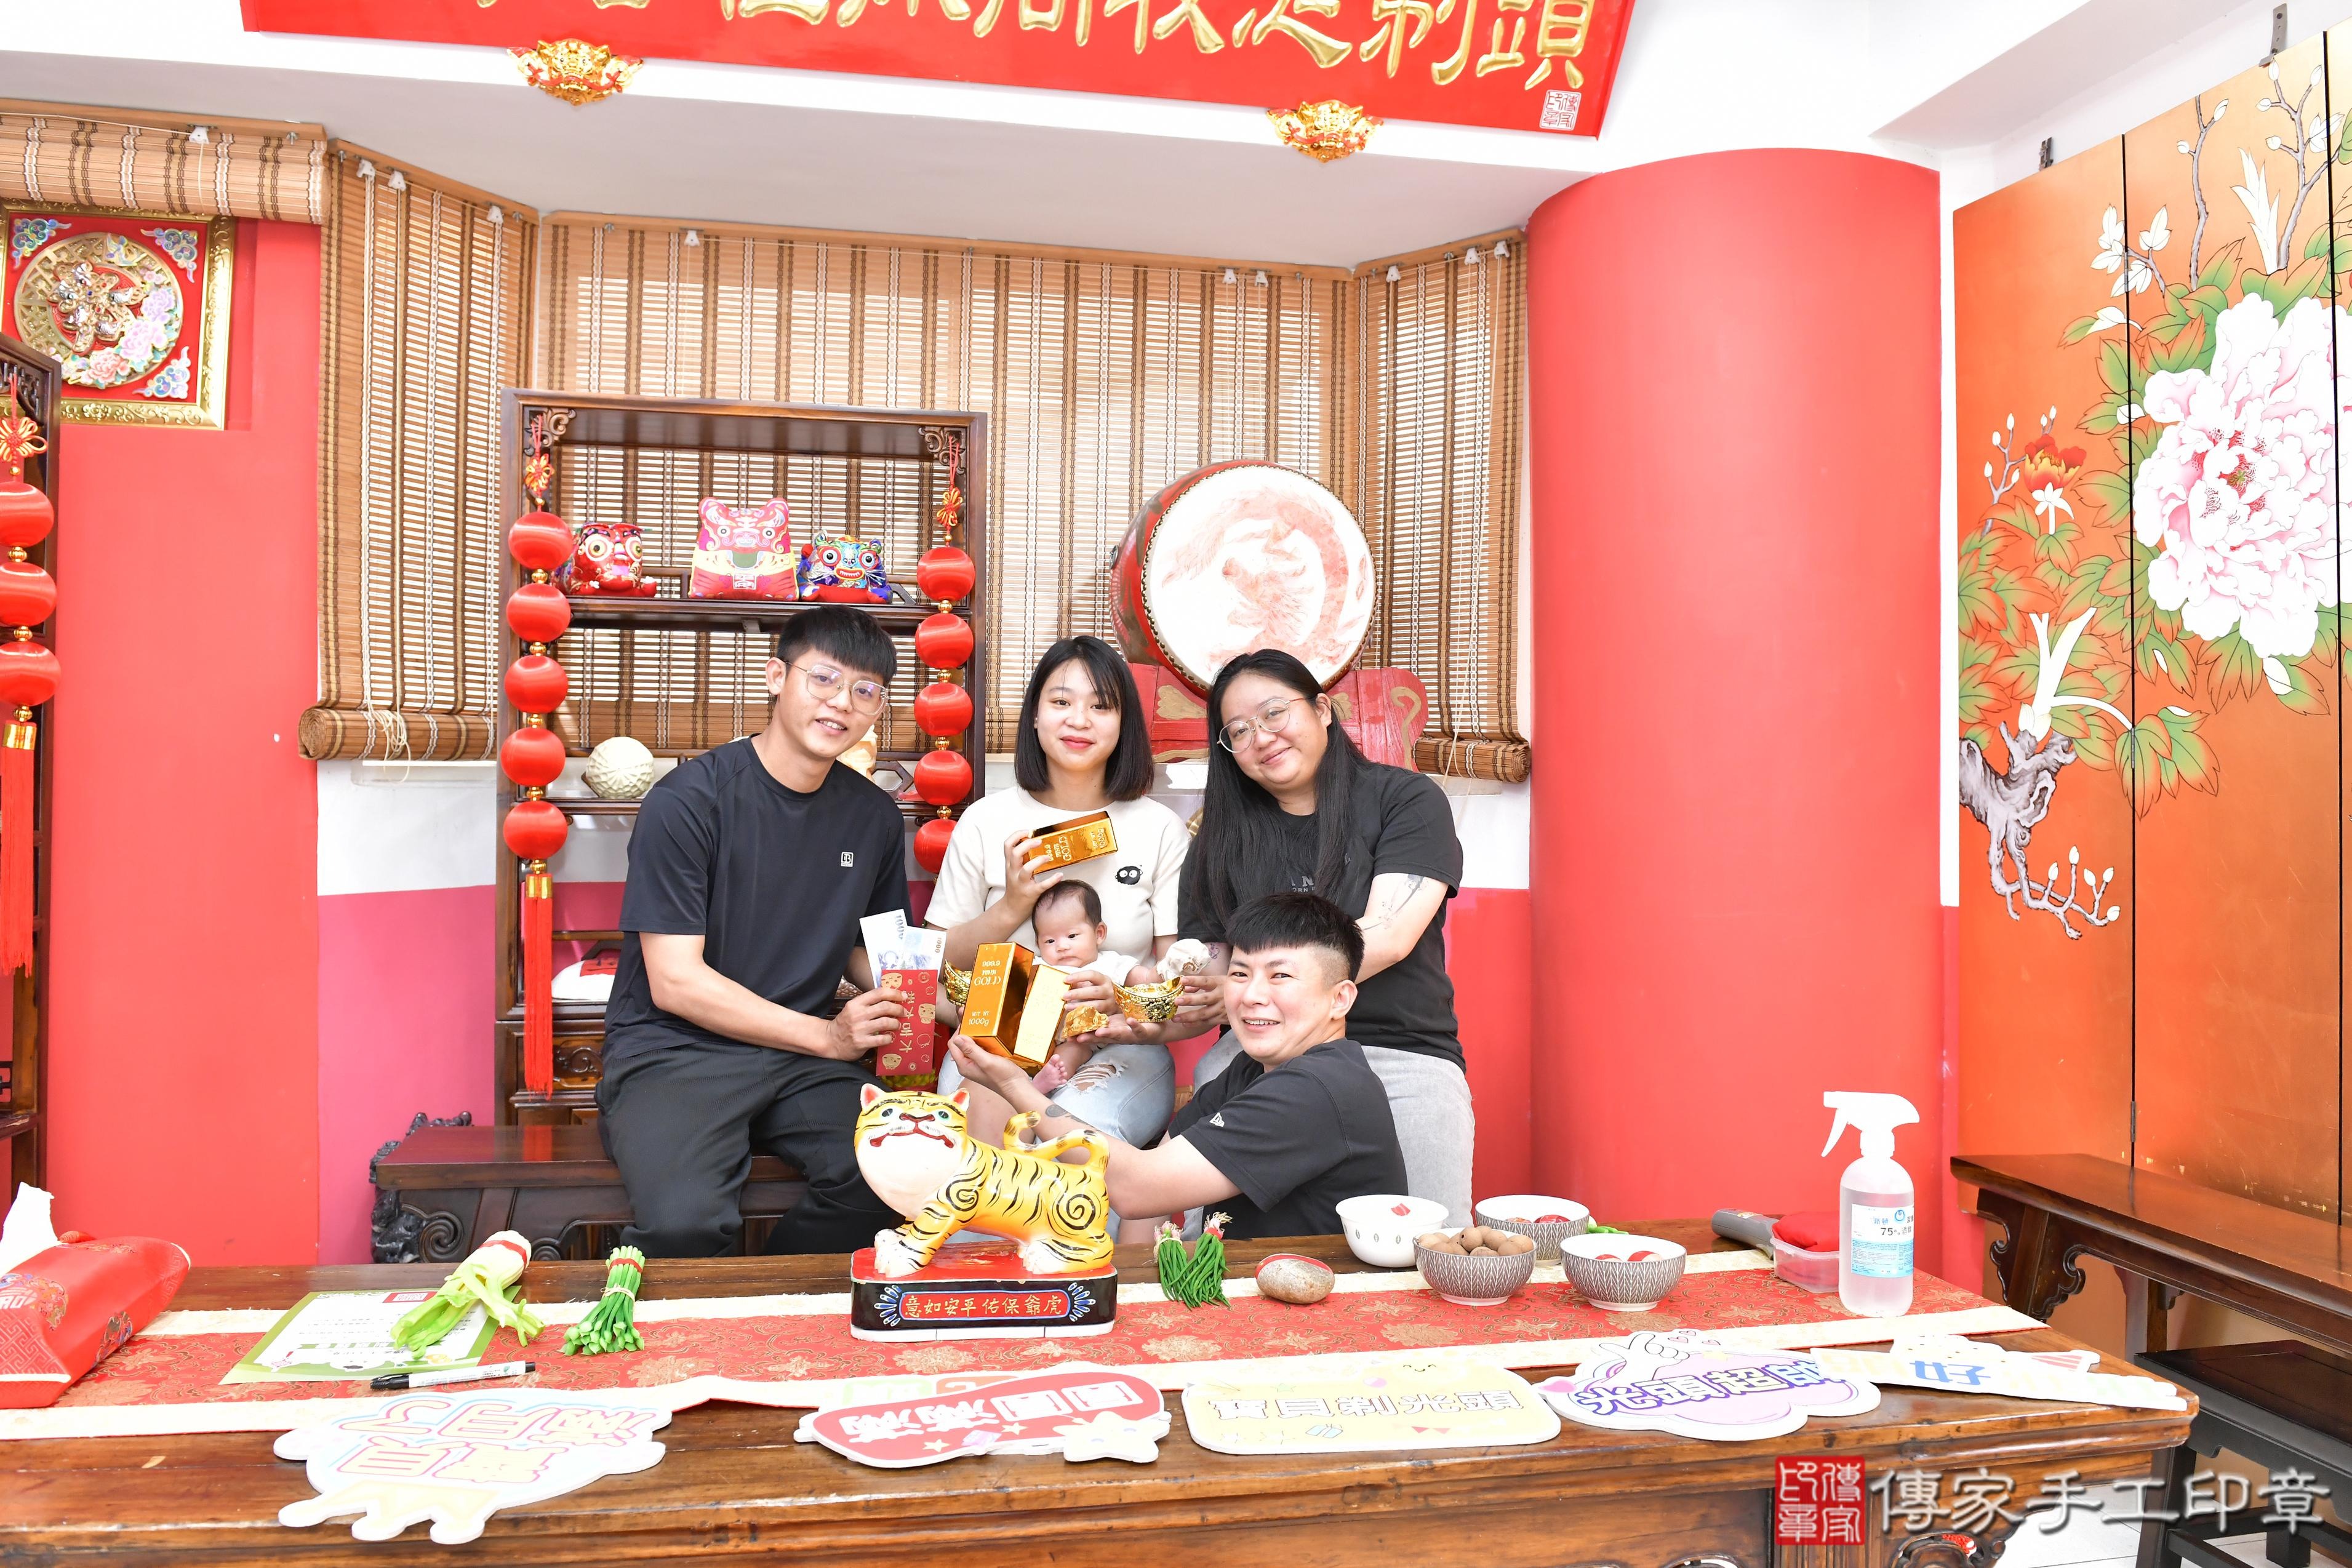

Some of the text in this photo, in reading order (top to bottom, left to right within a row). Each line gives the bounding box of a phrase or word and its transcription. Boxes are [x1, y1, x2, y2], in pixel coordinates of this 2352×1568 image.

[1058, 835, 1071, 861] GOLD
[974, 976, 1001, 986] GOLD
[969, 1018, 990, 1026] 1000g
[1207, 1390, 1525, 1420] 寶貝剃光頭
